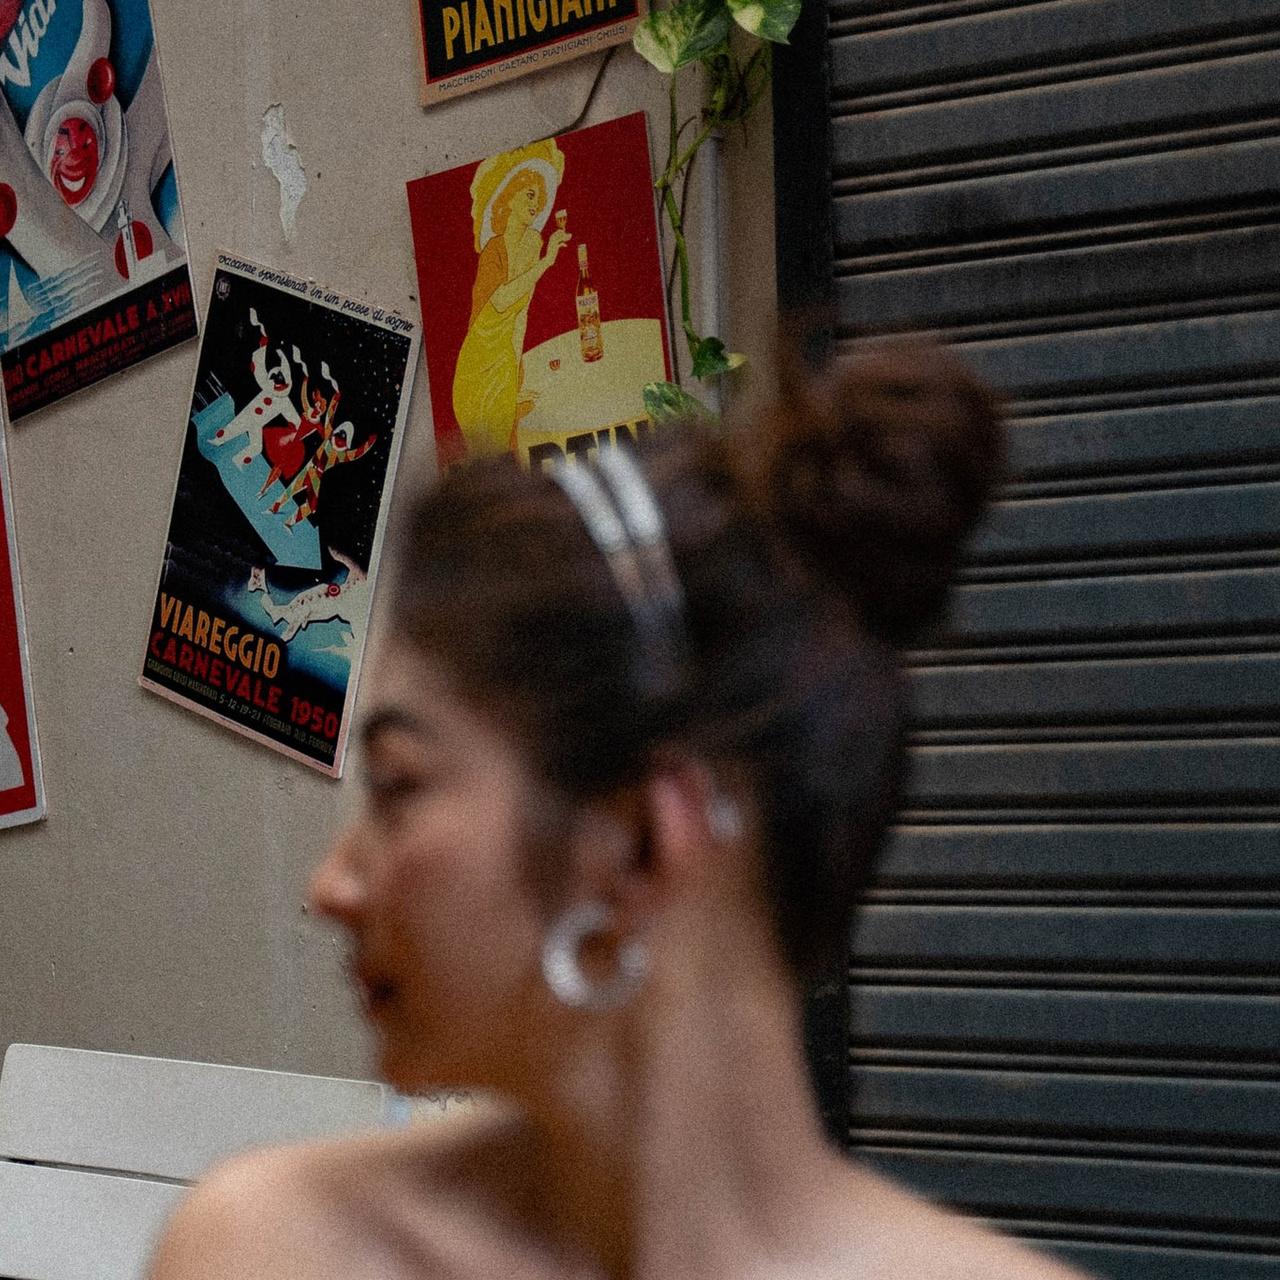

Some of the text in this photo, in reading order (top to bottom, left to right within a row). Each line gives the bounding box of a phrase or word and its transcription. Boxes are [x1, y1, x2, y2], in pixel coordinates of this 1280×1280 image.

[25, 303, 141, 380] CARNEVALE
[159, 591, 282, 680] VIAREGGIO
[149, 630, 339, 740] CARNEVALE 1950
